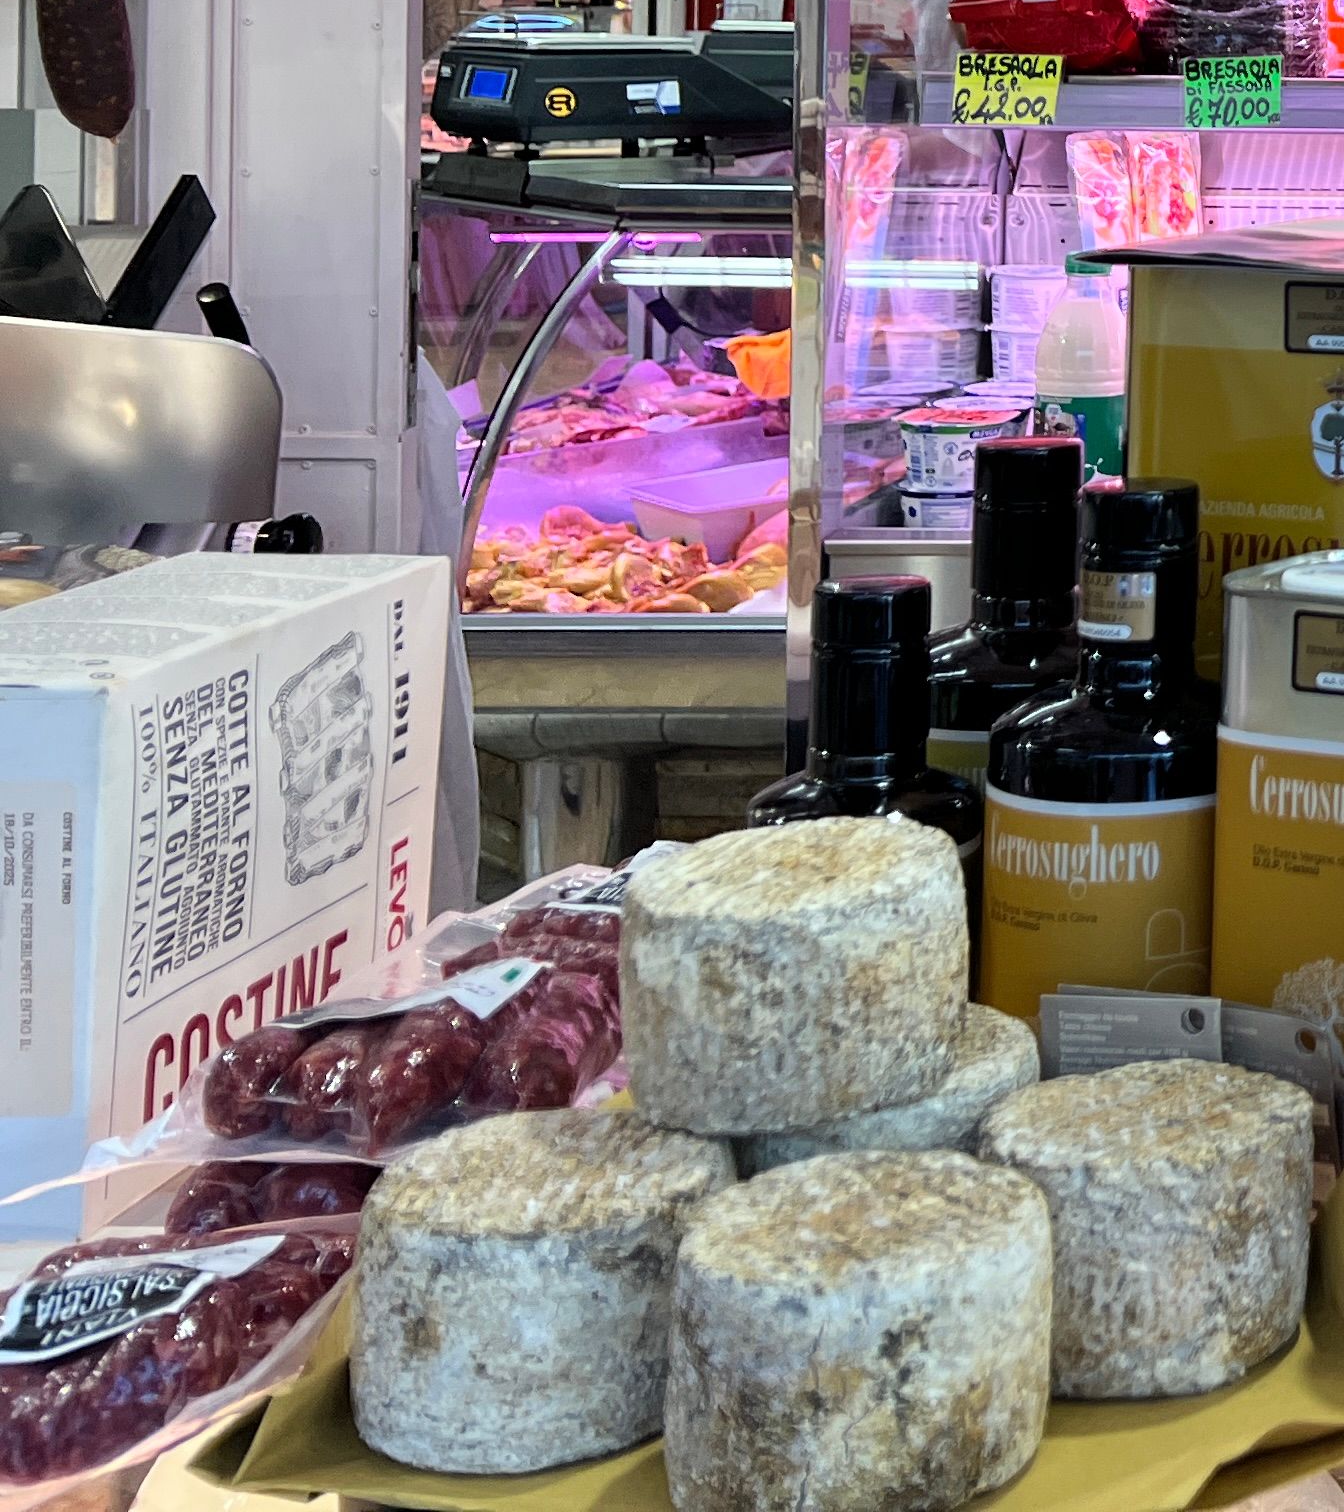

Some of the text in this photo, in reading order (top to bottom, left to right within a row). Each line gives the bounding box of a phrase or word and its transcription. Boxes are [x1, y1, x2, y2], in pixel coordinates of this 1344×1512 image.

[958, 54, 1059, 80] BRESAOLA
[1183, 57, 1280, 86] BRESAOLA
[1259, 502, 1325, 522] AGRICOLA
[214, 677, 227, 710] CON
[214, 717, 228, 767] SPEZIE
[124, 703, 158, 999] 100% ITALIANO
[149, 695, 189, 985] SENZA GLUTINE
[172, 689, 201, 970] SENZA GLUTAMMATO AGGIUNTO
[186, 682, 219, 962] DEL MEDITERRANEO
[218, 790, 231, 845] PIANTE
[221, 669, 250, 943] COTTE AL FORNO
[206, 853, 229, 954] AROMATICHE
[386, 835, 410, 952] LEVO
